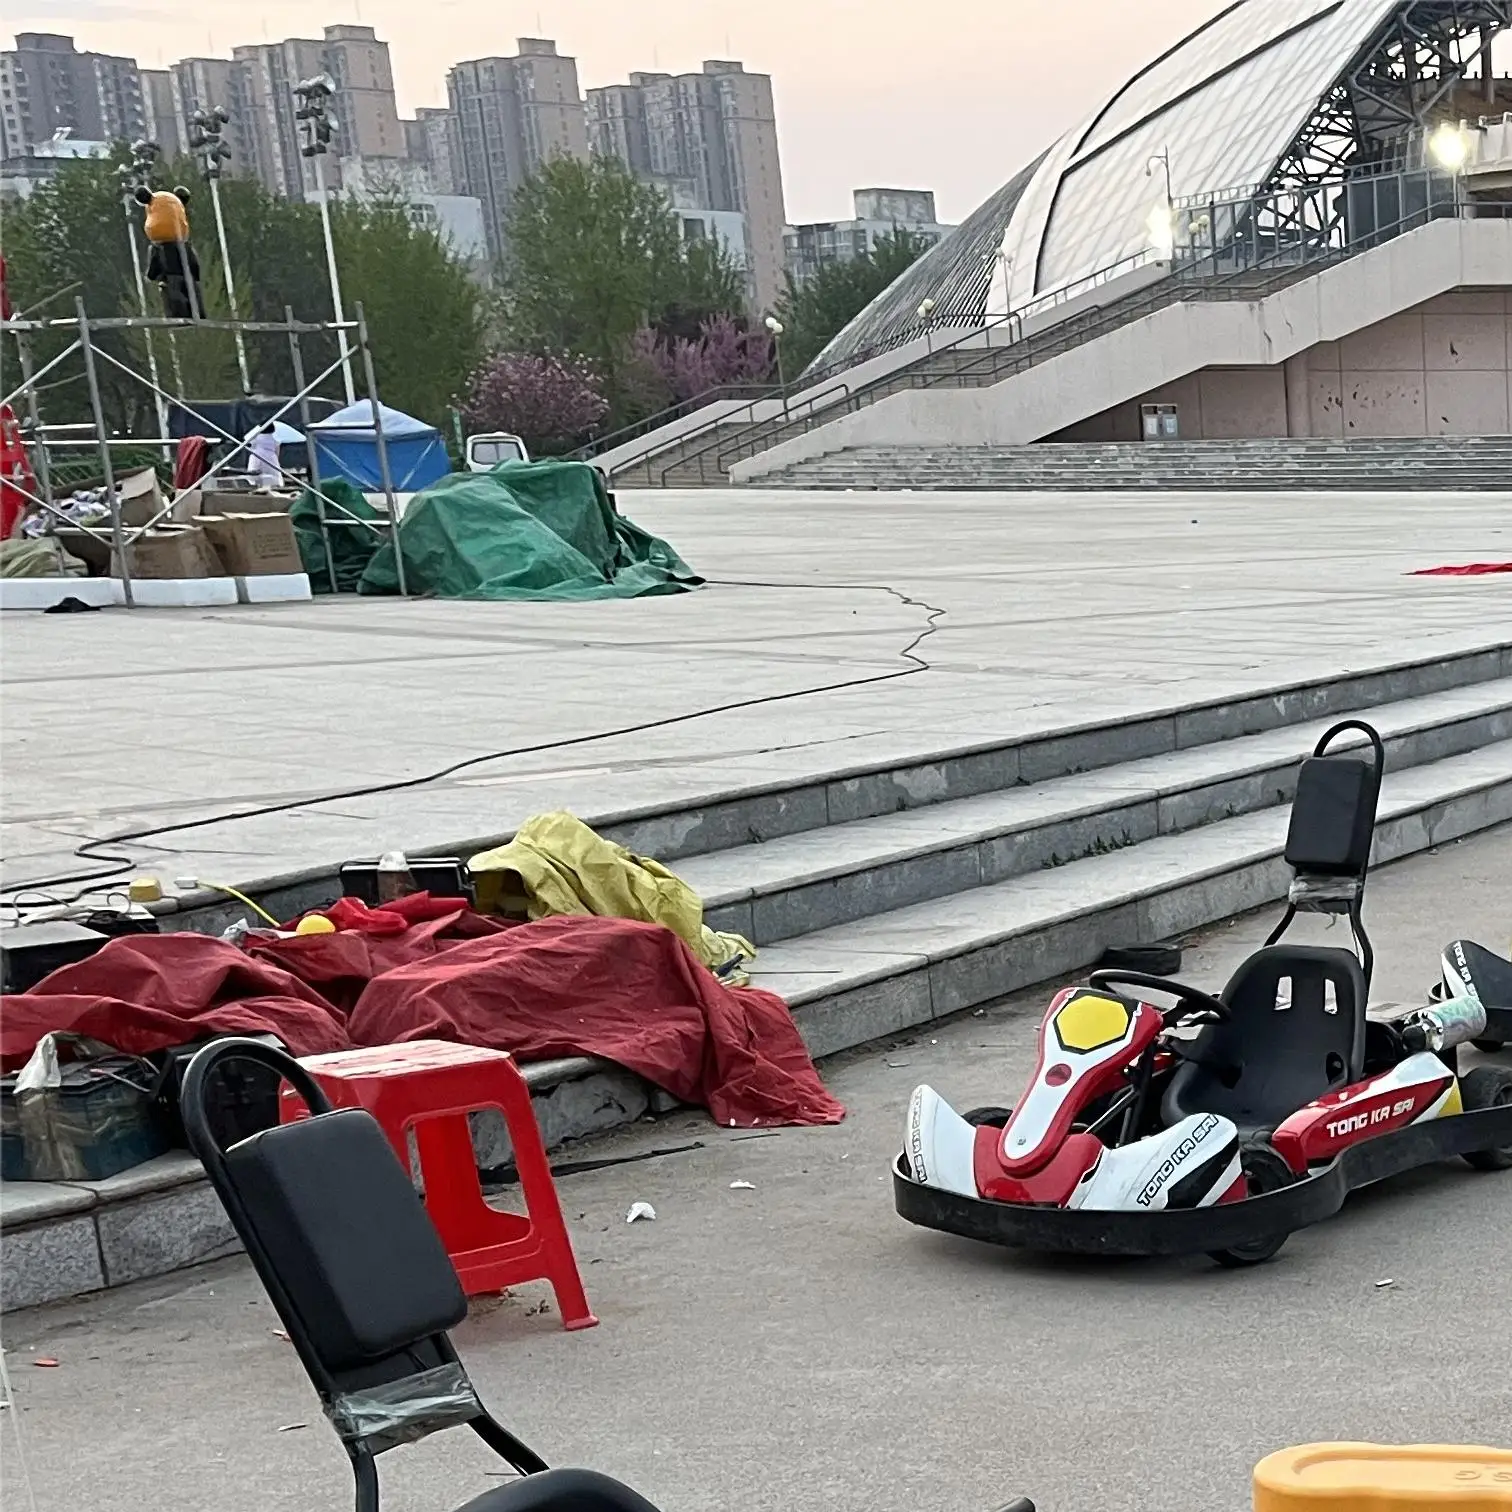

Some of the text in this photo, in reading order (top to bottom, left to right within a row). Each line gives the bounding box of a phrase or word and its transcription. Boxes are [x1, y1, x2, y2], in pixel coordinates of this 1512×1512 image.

[1326, 1096, 1416, 1138] TONG KA SAI
[1136, 1113, 1219, 1207] TONG KA SAI
